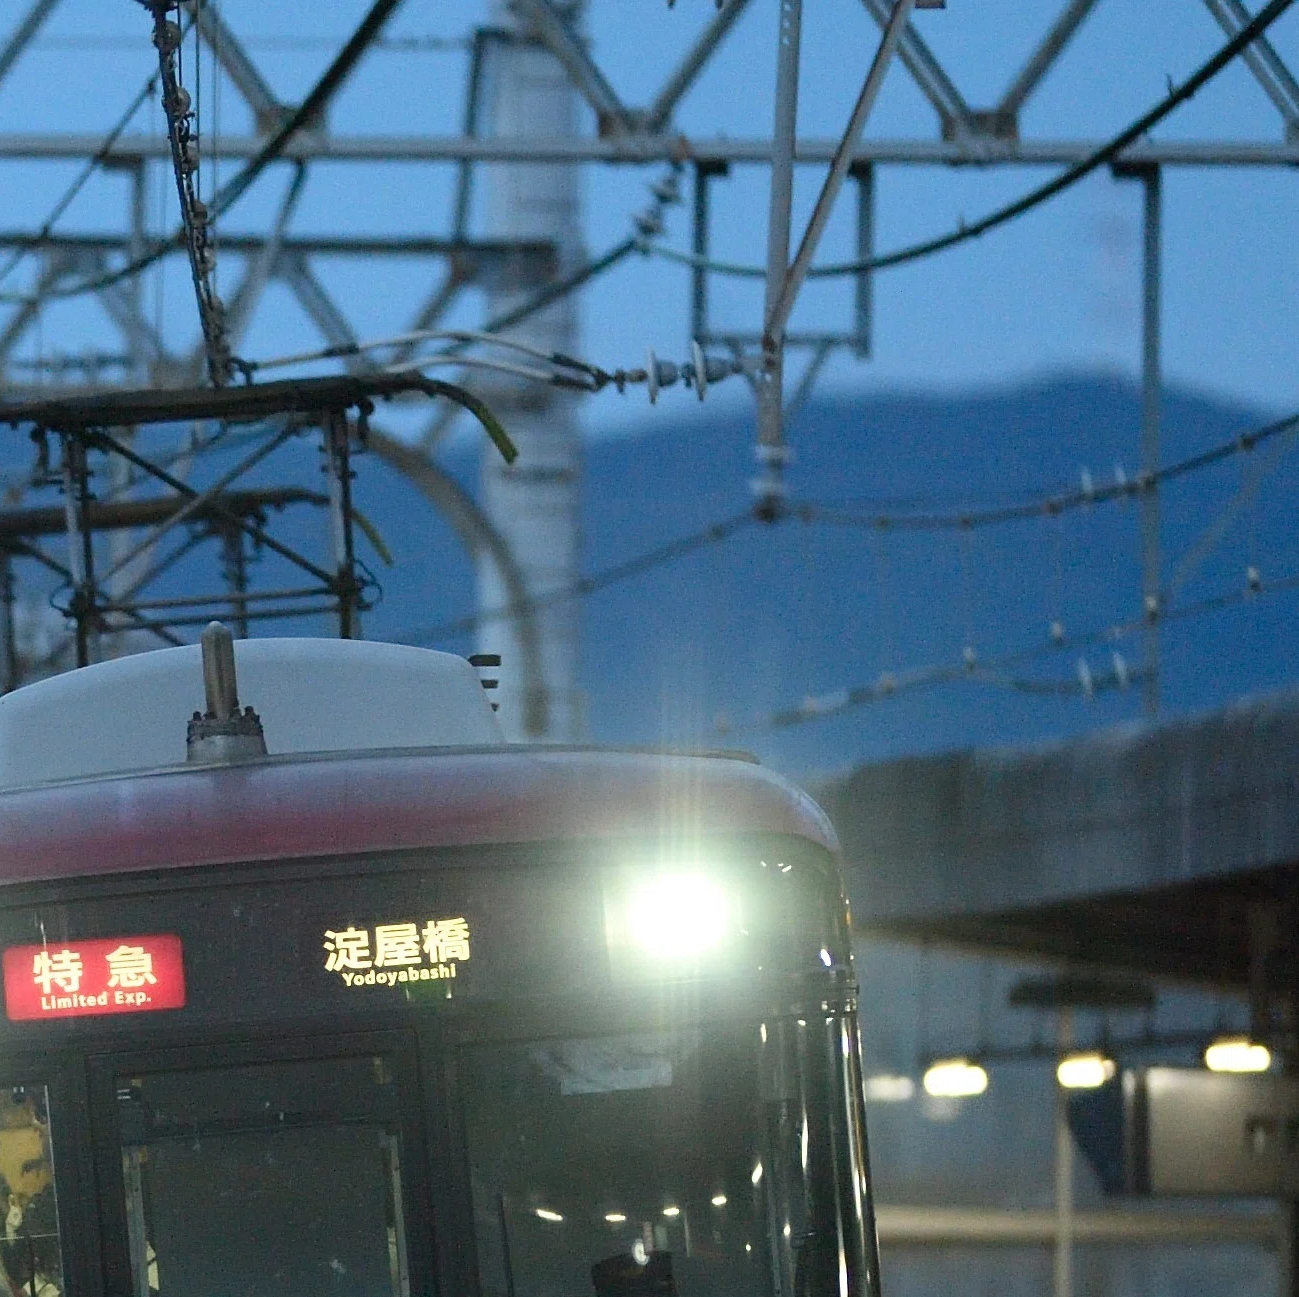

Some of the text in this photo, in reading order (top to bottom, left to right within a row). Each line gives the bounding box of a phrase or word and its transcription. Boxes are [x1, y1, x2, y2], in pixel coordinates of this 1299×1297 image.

[322, 917, 471, 972] 淀屋橋
[33, 945, 158, 994] 特急
[341, 962, 457, 987] Yodoyabashi
[41, 990, 152, 1010] Limited Exp.
